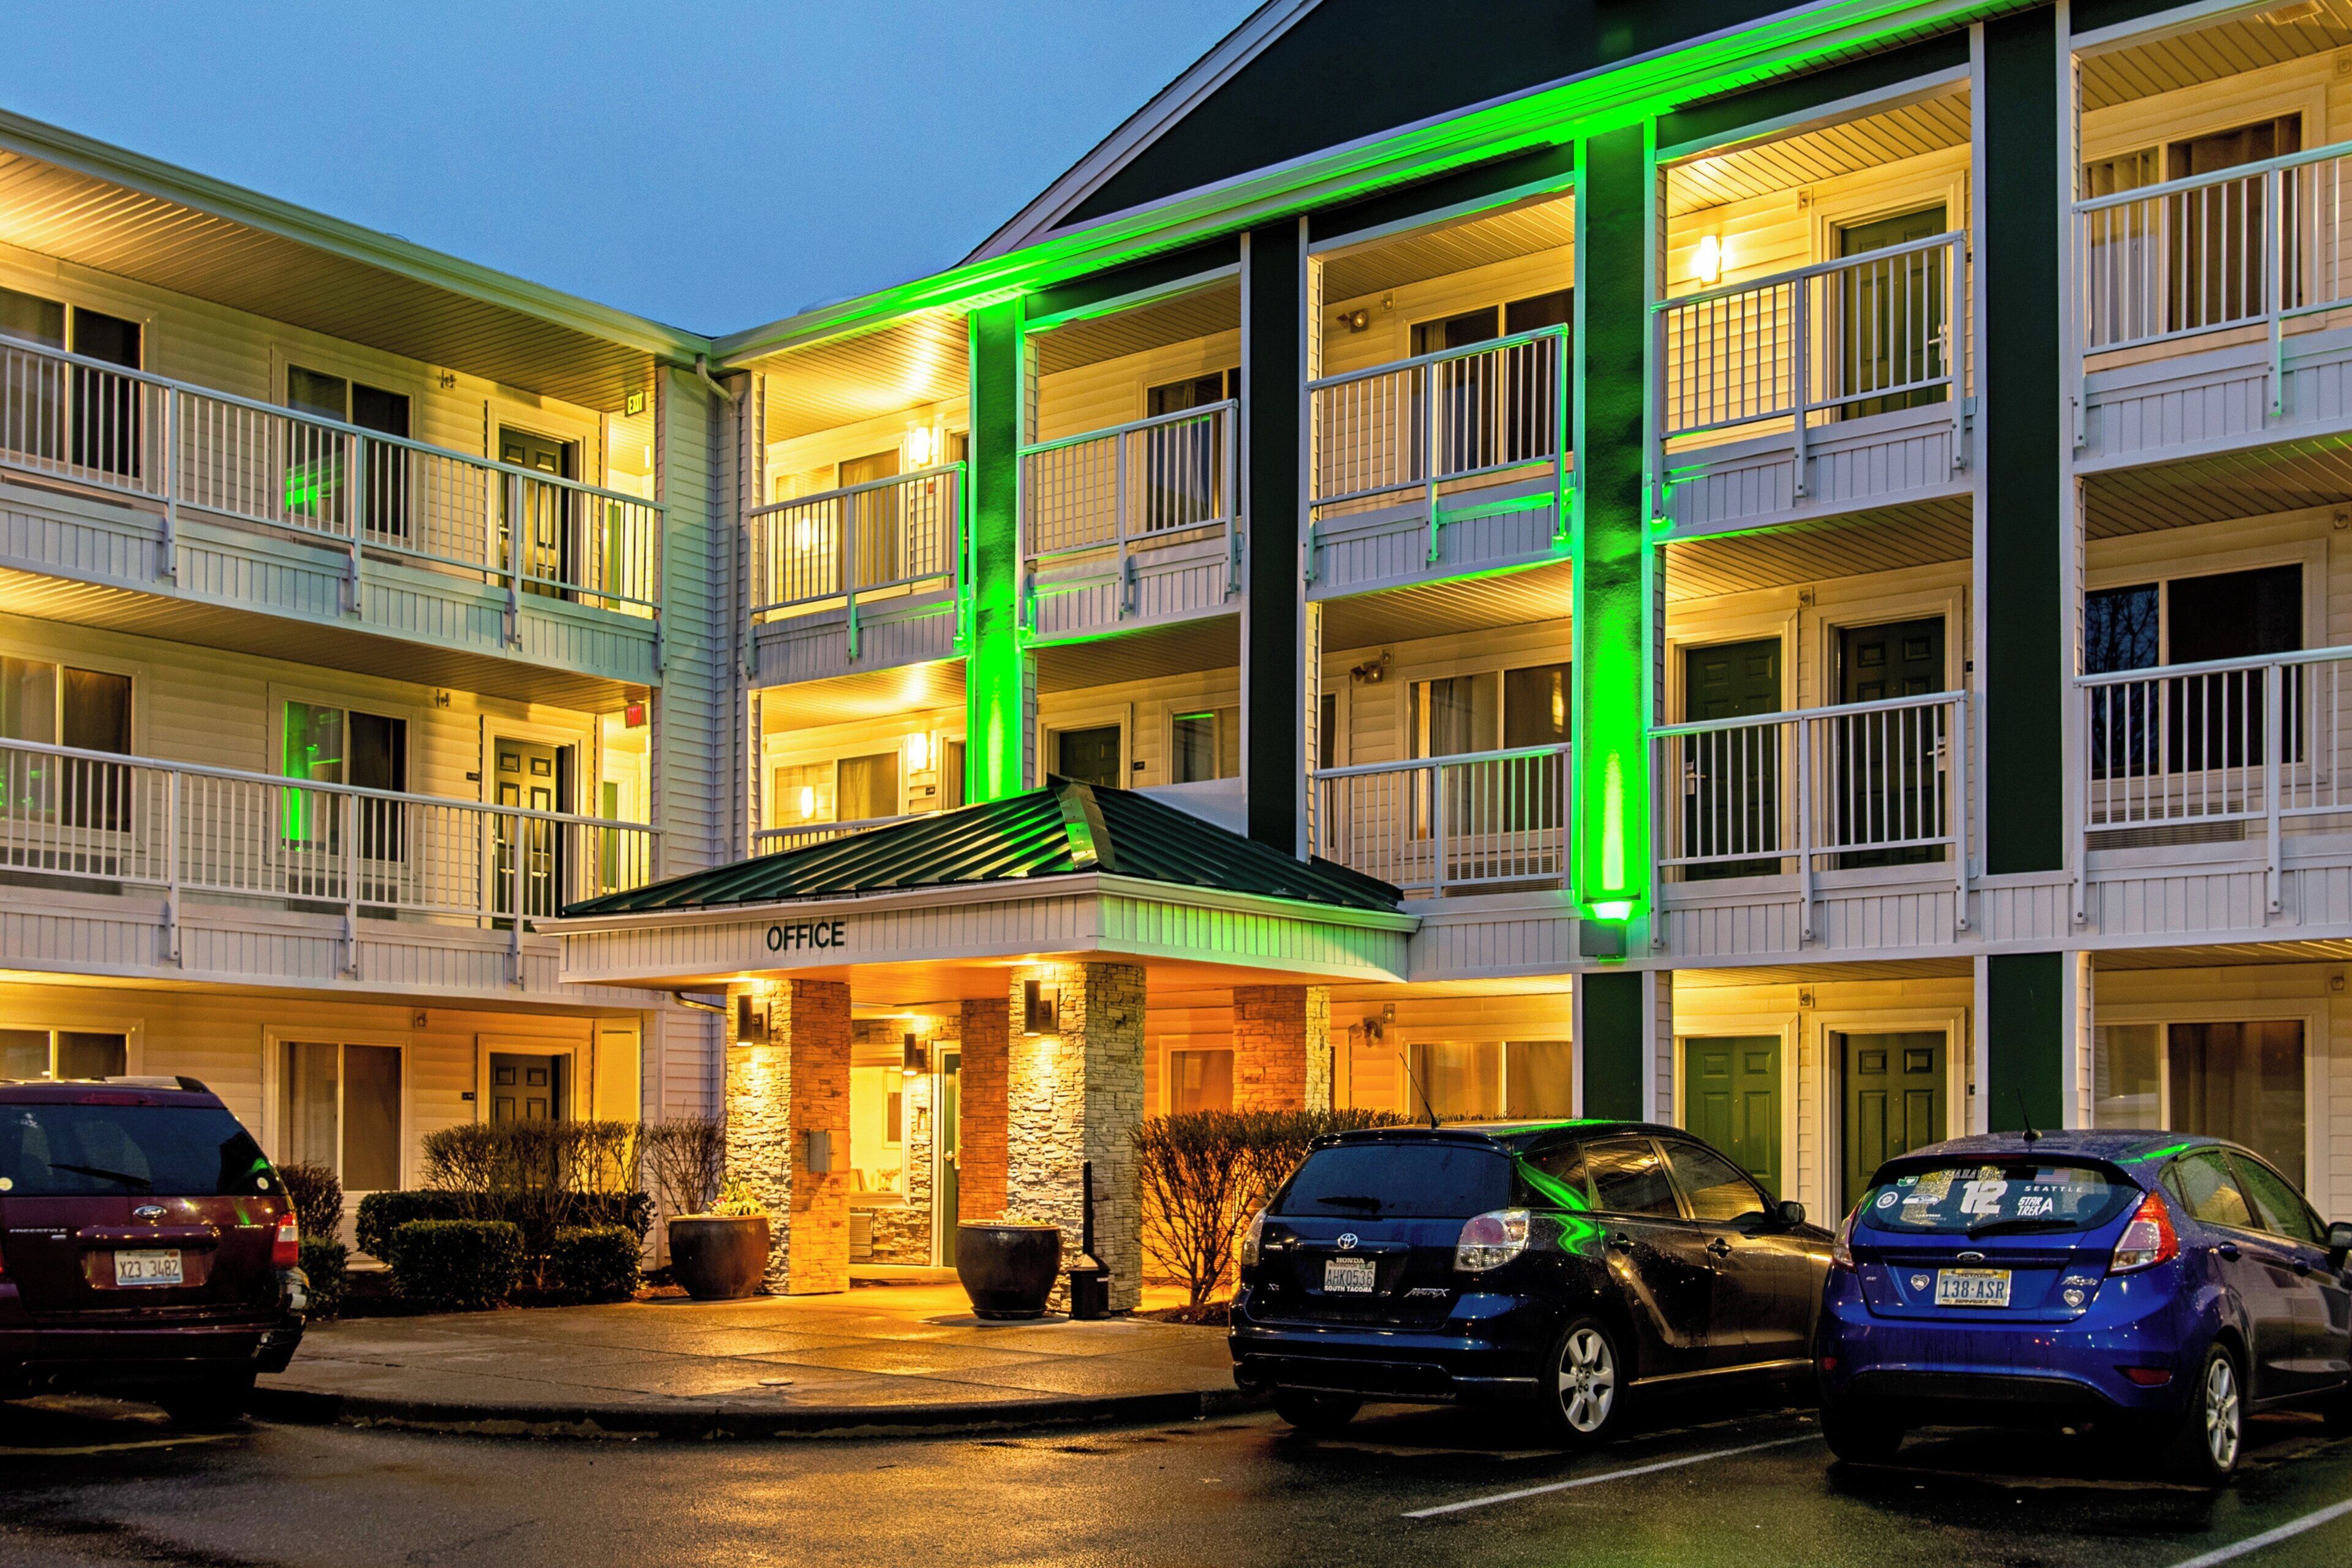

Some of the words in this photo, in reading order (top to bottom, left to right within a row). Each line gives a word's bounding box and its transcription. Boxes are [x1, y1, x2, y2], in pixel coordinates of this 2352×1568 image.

[627, 393, 643, 415] EXIT
[767, 921, 846, 952] OFFICE
[1960, 1181, 2008, 1213] 12
[2017, 1196, 2043, 1206] STAR
[2017, 1205, 2041, 1216] TREK
[119, 1261, 142, 1279] X23
[149, 1259, 180, 1278] 3482
[1327, 1269, 1373, 1286] AHK0536
[1403, 1287, 1450, 1298] MATRIX
